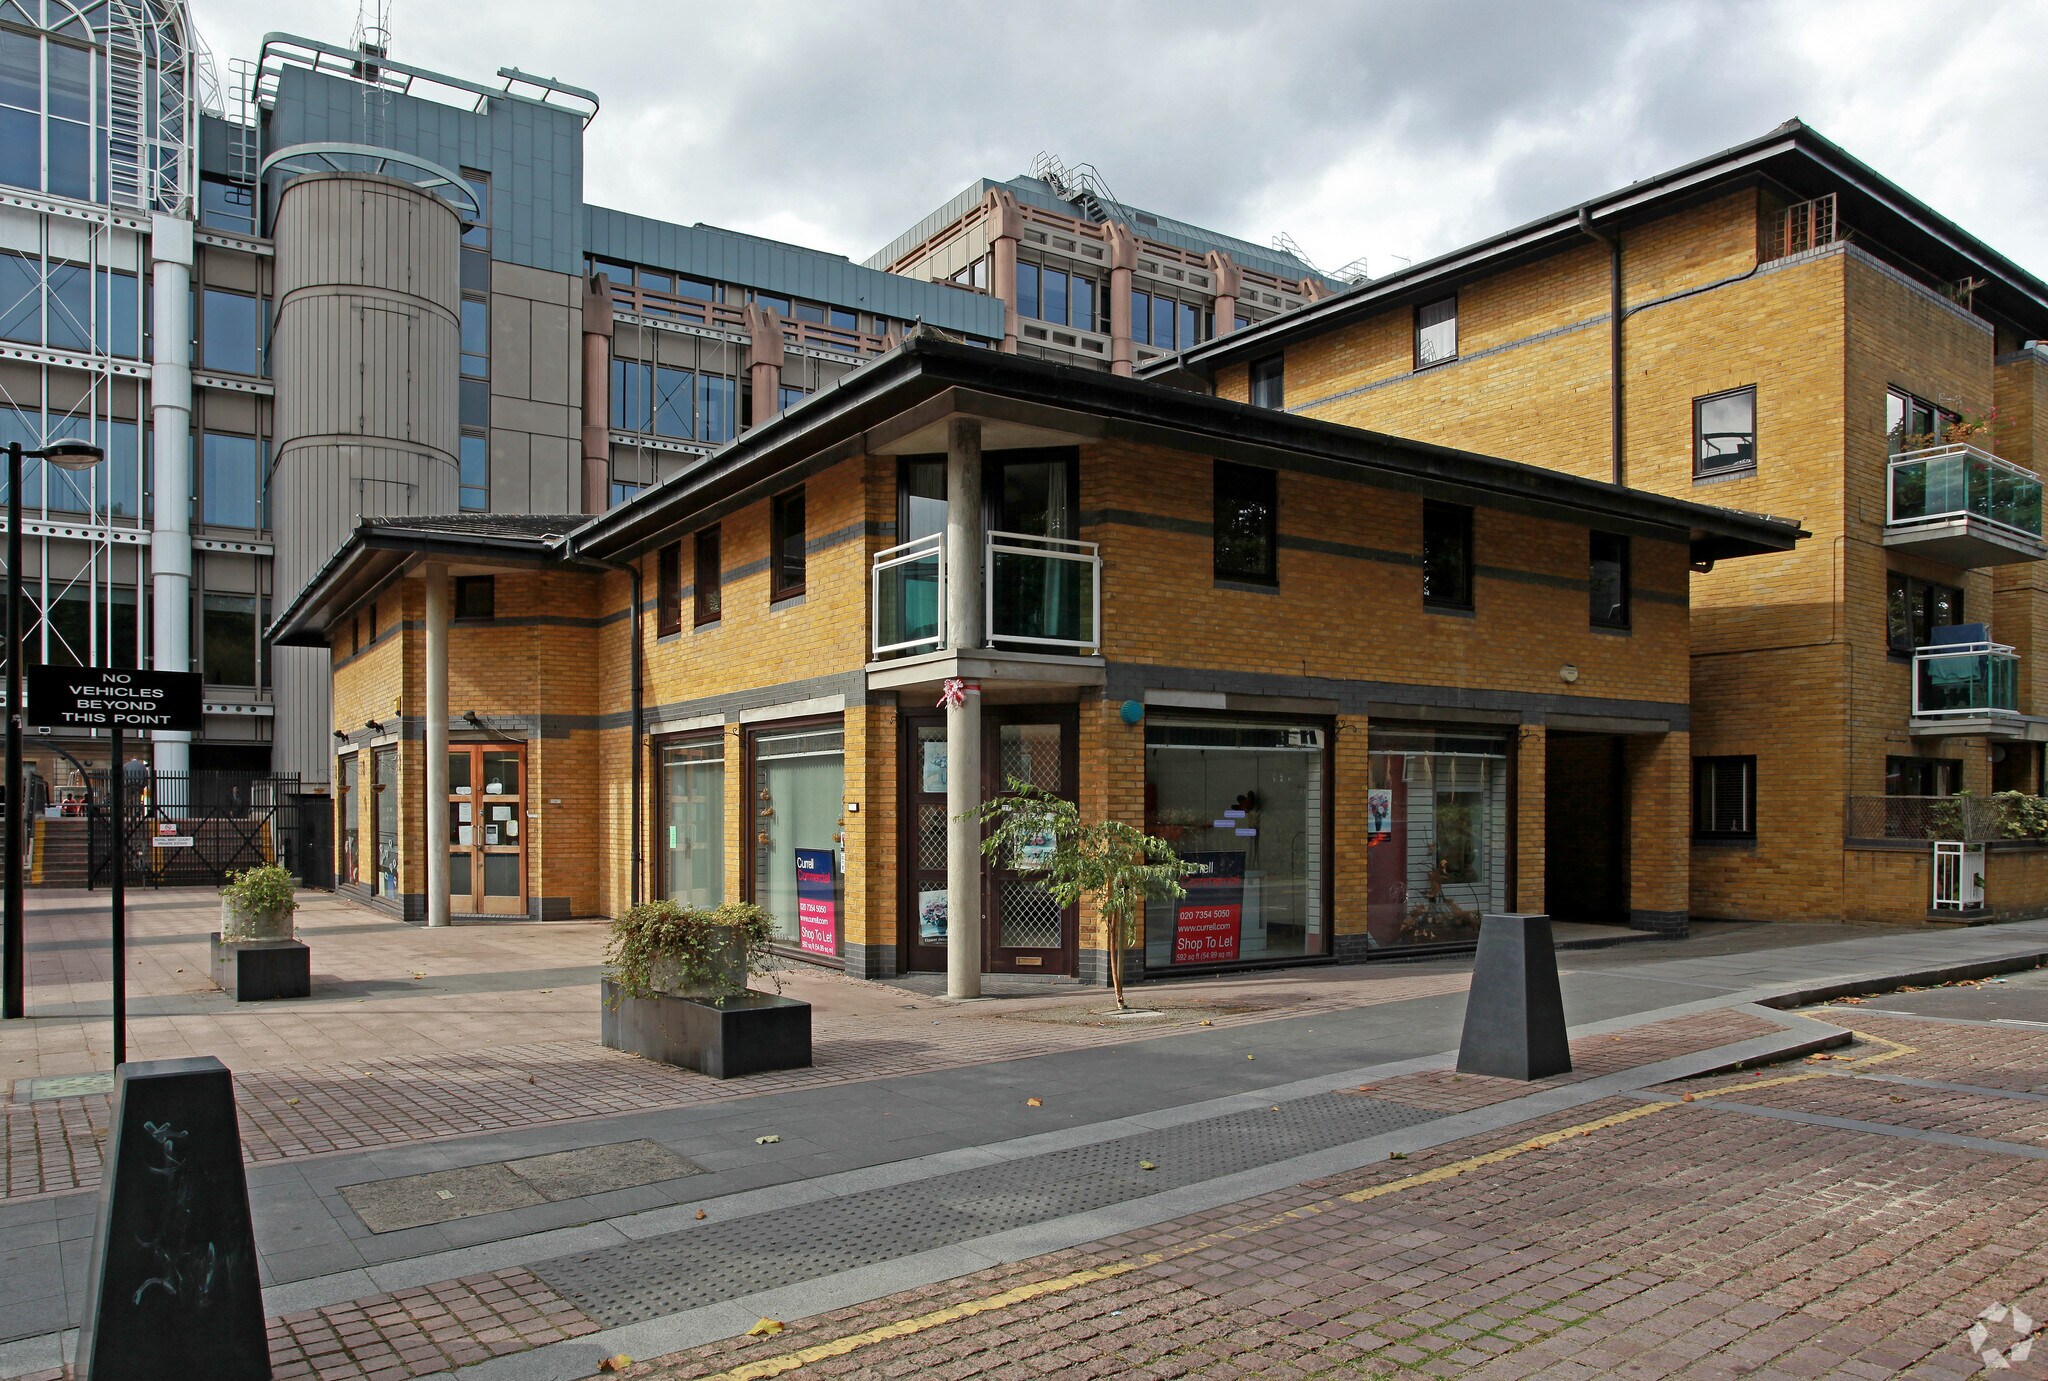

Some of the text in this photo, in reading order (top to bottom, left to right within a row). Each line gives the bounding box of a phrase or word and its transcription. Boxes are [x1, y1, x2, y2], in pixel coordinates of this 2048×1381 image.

[102, 673, 132, 684] NO
[69, 685, 165, 699] VEHICLES
[77, 699, 157, 711] BEYOND
[61, 712, 171, 725] THIS POINT
[1180, 910, 1230, 920] 020 7354 5050
[1178, 923, 1230, 932] www.currell.com
[801, 926, 832, 943] Shop To Let
[1177, 936, 1233, 951] Shop To Let
